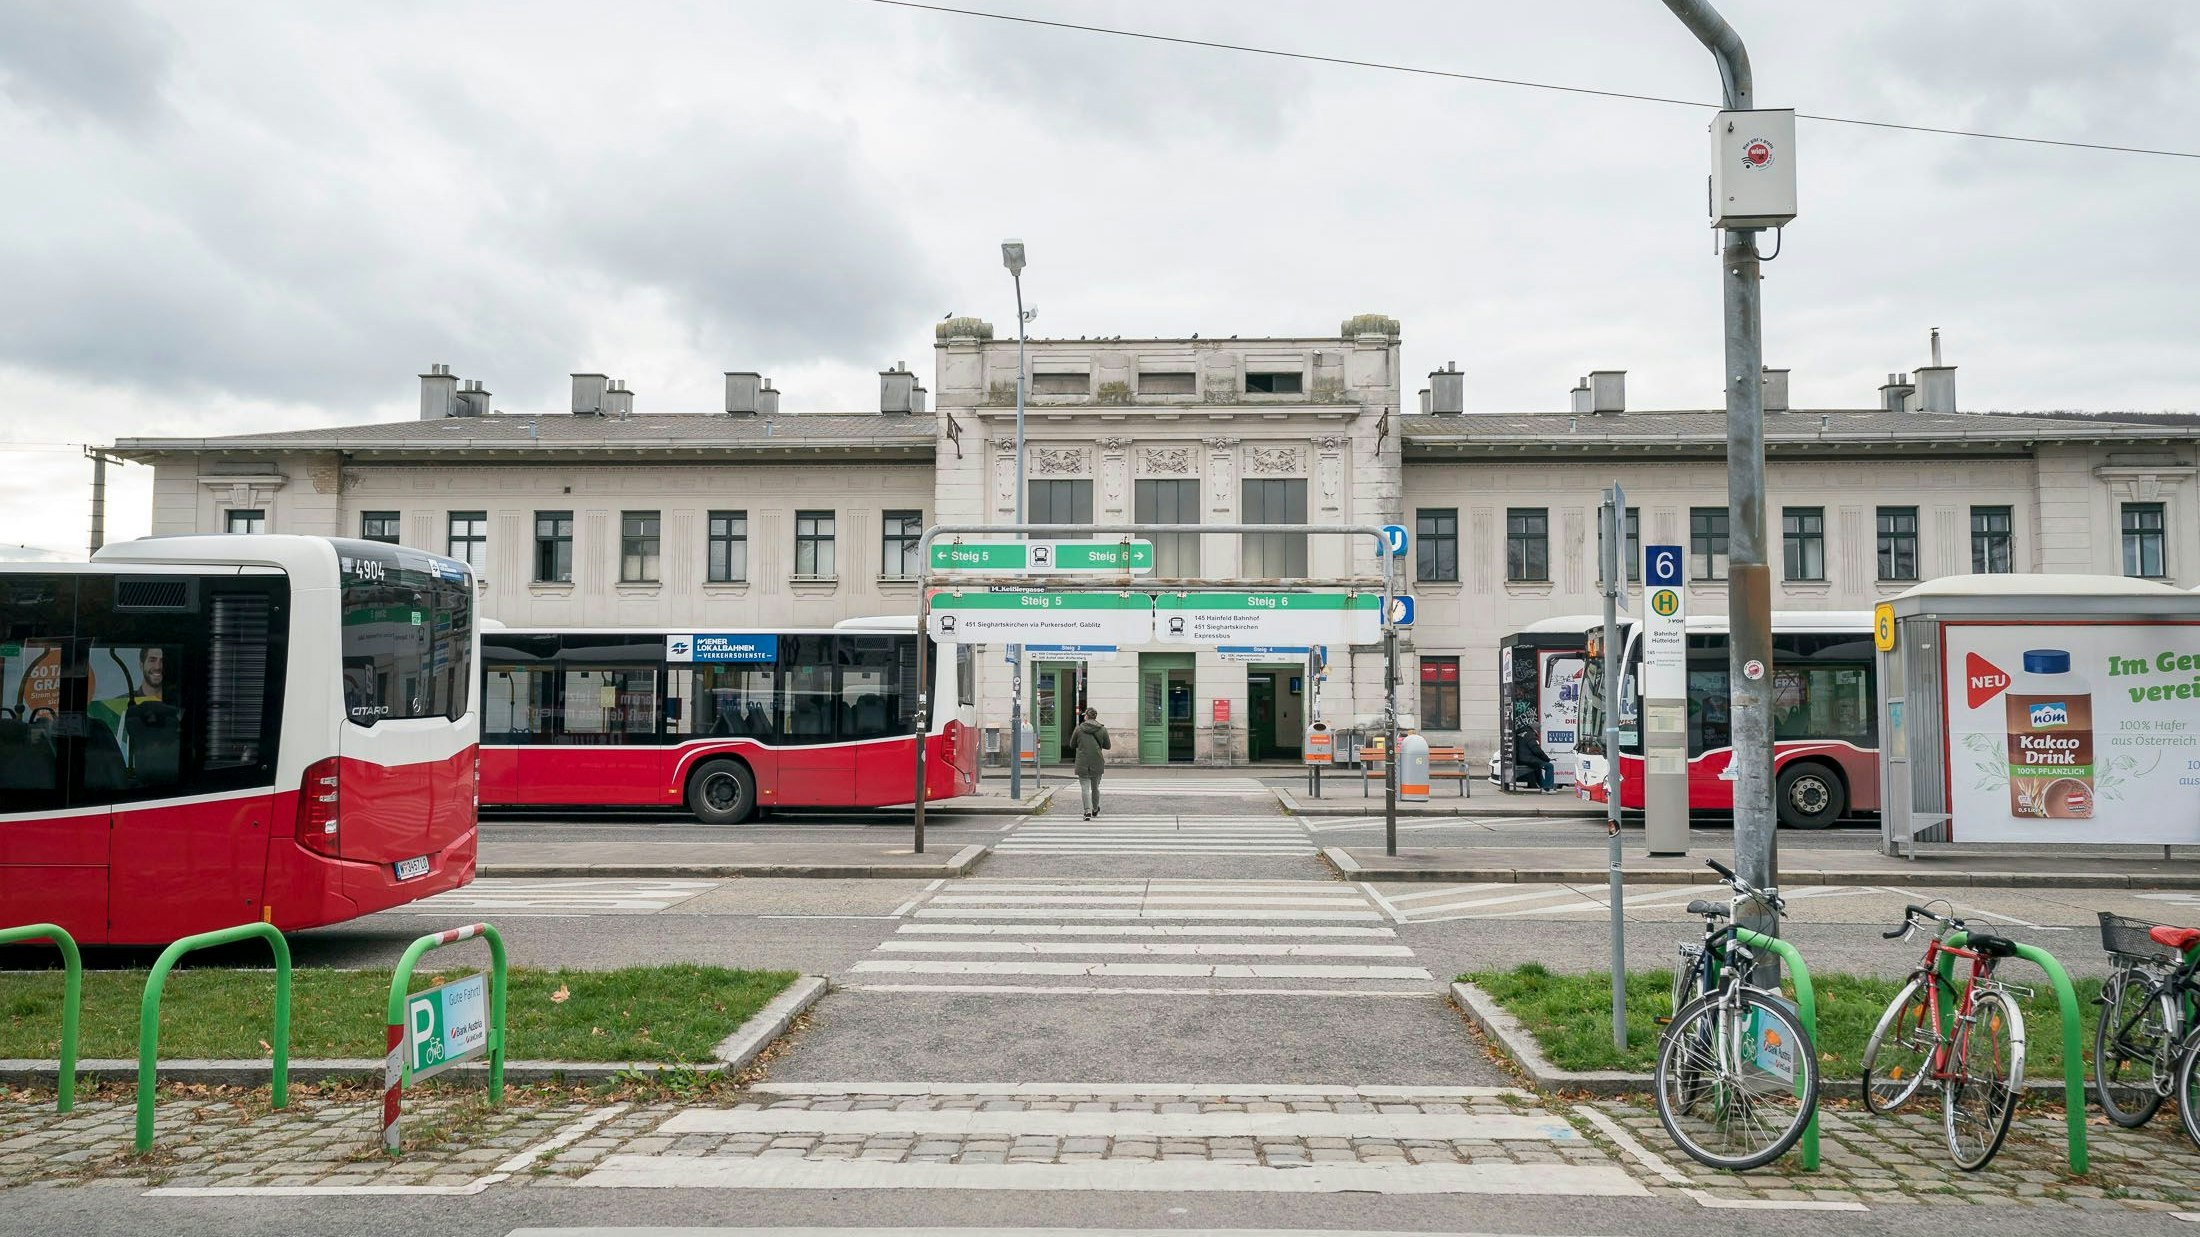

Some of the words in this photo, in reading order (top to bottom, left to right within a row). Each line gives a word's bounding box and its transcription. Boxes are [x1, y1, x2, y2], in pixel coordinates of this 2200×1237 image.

[1383, 531, 1402, 551] U
[951, 551, 980, 563] Steig
[982, 551, 989, 561] 5
[1089, 551, 1117, 563] Steig
[1122, 552, 1129, 561] 6
[356, 560, 385, 580] 4904
[1656, 552, 1674, 579] 6
[1021, 596, 1049, 607] Steig
[1055, 596, 1062, 606] 5
[1248, 597, 1276, 608] Steig
[1281, 597, 1288, 606] 6
[1659, 595, 1673, 611] H
[977, 621, 1029, 629] Sieghartskirchen
[1880, 617, 1888, 640] 6
[31, 665, 48, 678] 60
[2108, 656, 2149, 676] Im
[1971, 674, 2006, 689] NEU
[352, 706, 389, 716] CITARO
[2120, 720, 2151, 731] 100%
[2155, 720, 2188, 732] Hafer
[2020, 735, 2080, 749] Kakao
[2111, 736, 2132, 746] aus
[2135, 734, 2197, 746] Österreich
[2025, 750, 2076, 764] Drink
[2038, 767, 2085, 775] PFLANZLICH
[2179, 777, 2200, 786] aus
[449, 992, 463, 1006] Gute
[411, 999, 435, 1070] P
[456, 1024, 468, 1037] Bank
[468, 1019, 483, 1032] Austria
